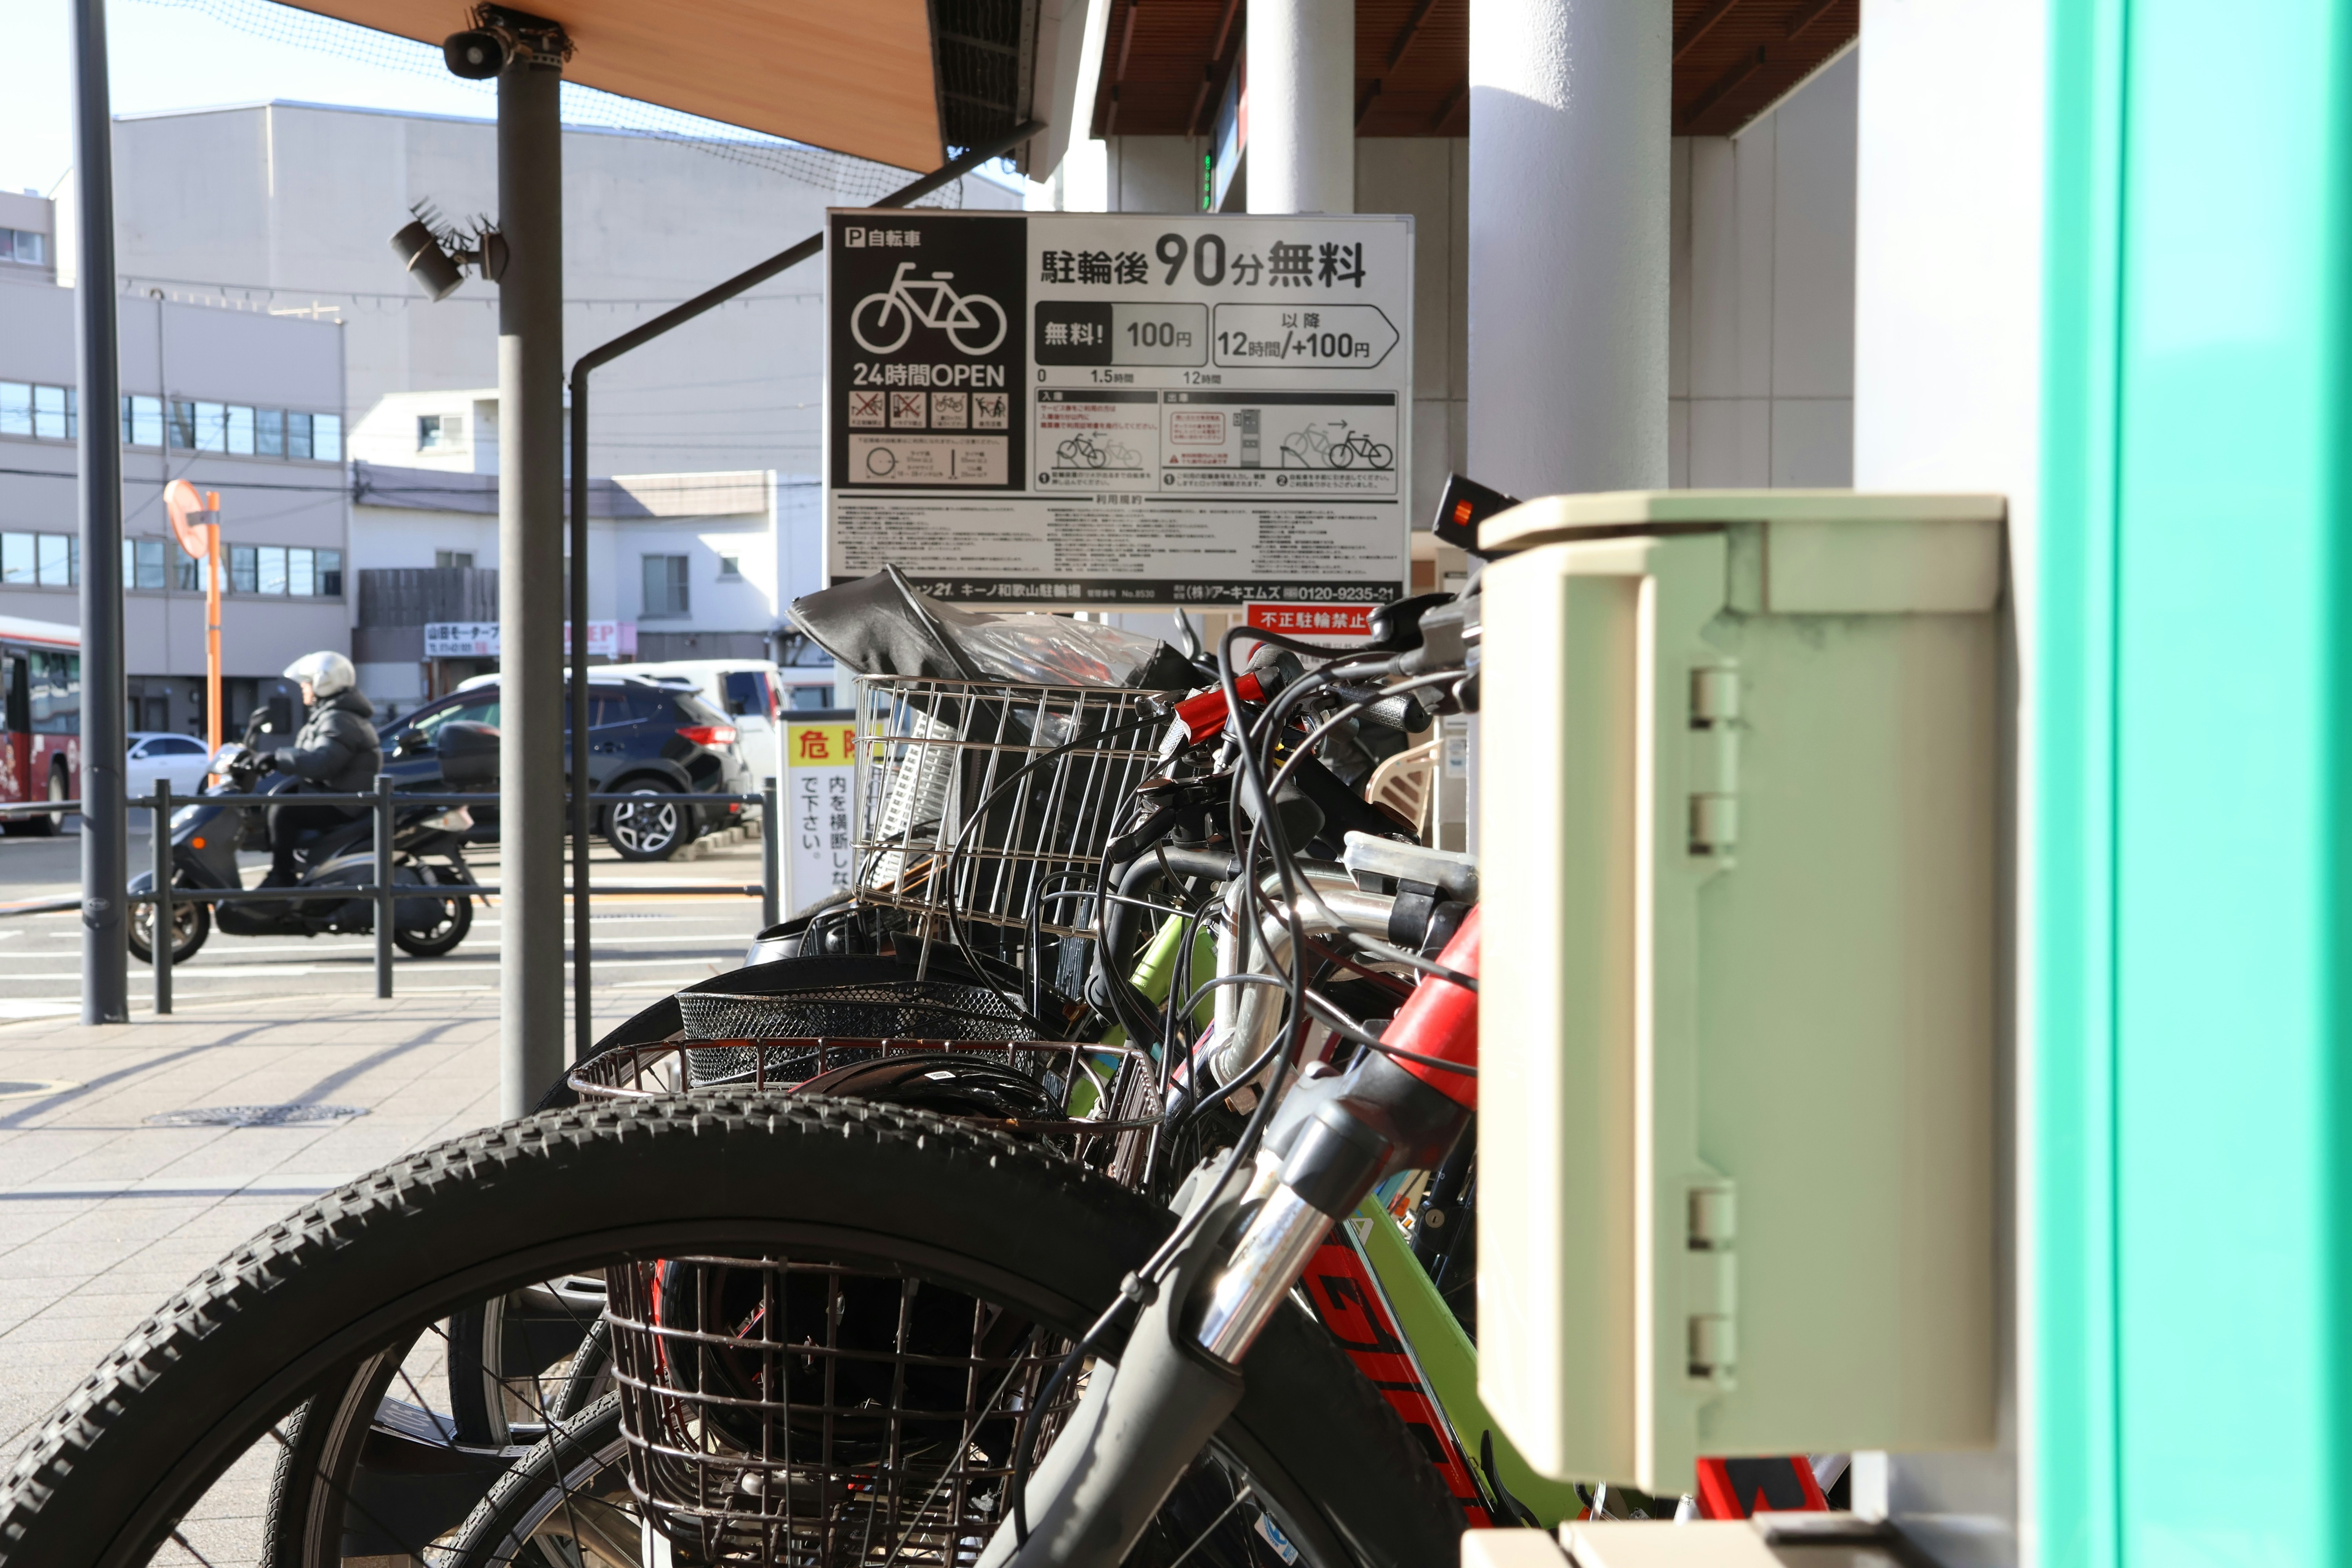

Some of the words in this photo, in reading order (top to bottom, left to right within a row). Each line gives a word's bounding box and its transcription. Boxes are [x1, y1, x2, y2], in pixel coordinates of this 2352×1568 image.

[869, 229, 920, 247] 自転車
[1041, 233, 1366, 289] 駐輪後90分無料
[1282, 313, 1320, 329] 以降
[1045, 321, 1103, 345] 無料!
[1127, 322, 1192, 347] 100円
[853, 363, 1004, 387] 24時間OPEN
[1037, 368, 1046, 382] 0
[1091, 369, 1134, 384] 1.5時間
[1183, 371, 1221, 385] 12時間
[1298, 587, 1394, 601] 0120-9235-21
[1260, 612, 1366, 628] 不正駐輪禁止
[801, 776, 821, 859] で下さい。
